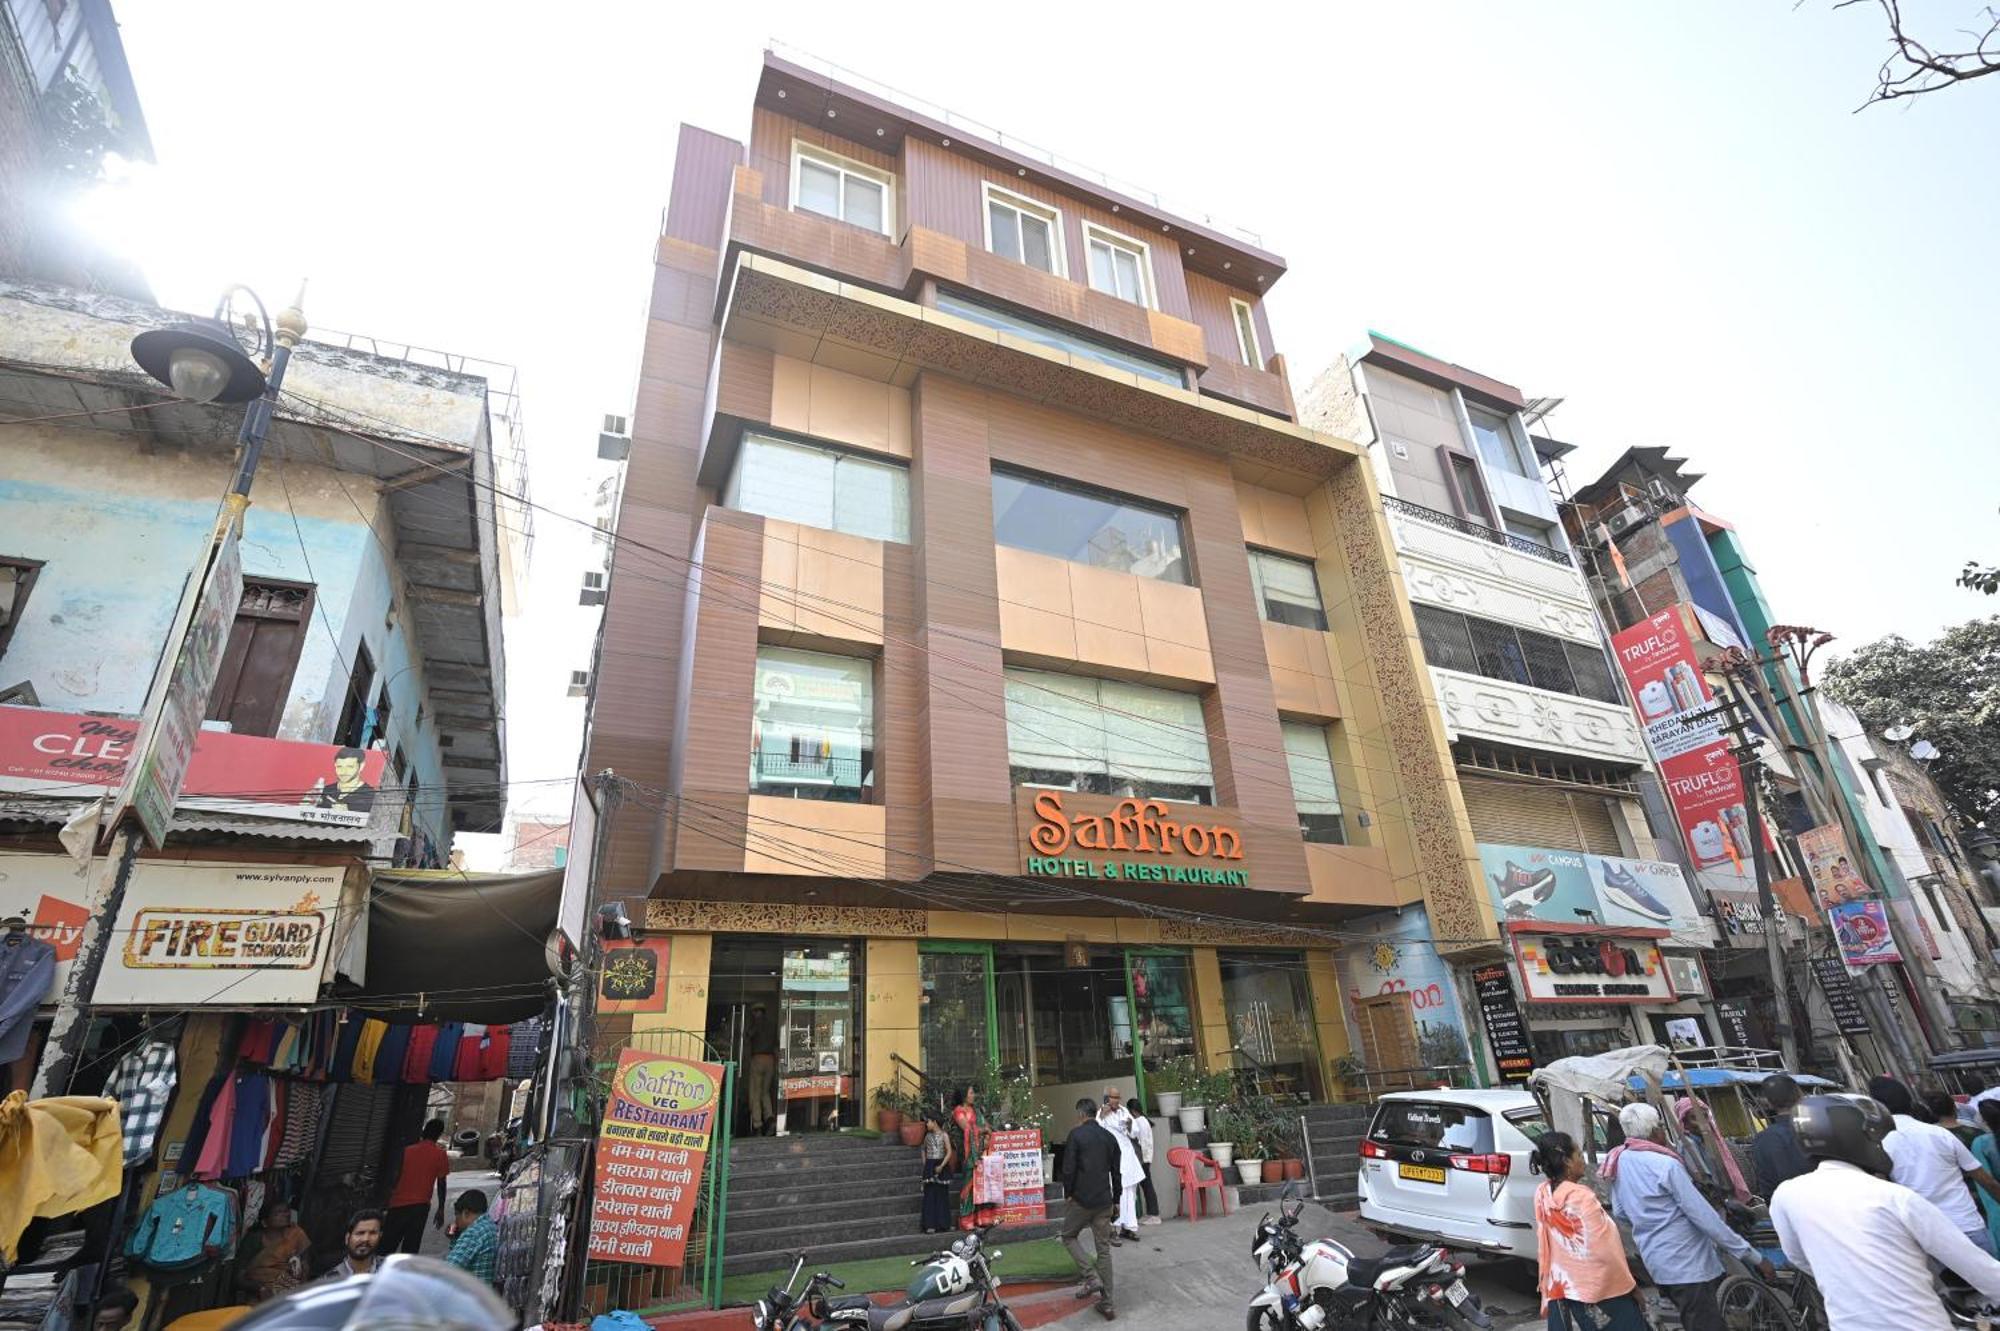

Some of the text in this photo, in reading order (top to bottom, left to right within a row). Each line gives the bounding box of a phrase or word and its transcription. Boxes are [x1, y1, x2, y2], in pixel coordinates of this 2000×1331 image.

[33, 734, 131, 760] CLE
[1030, 790, 1244, 860] Saffron
[236, 872, 334, 884] www.sylvanply.com
[1028, 857, 1248, 887] HOTEL & RESTAURANT
[140, 919, 313, 957] FIRE GUARD
[241, 943, 310, 957] TECHNOLOGY
[630, 1065, 705, 1100] Saffron
[652, 1096, 679, 1109] VEG
[614, 1099, 709, 1131] RESTAURANT
[636, 1126, 647, 1139] की
[657, 1150, 689, 1166] थाली
[606, 1162, 692, 1185] महाराजा थाली
[601, 1178, 682, 1202] डीलक्स थाली
[596, 1197, 673, 1220] स्पेशल थाली
[591, 1219, 619, 1234] साउथ
[659, 1223, 684, 1240] थाली
[588, 1234, 653, 1257] मिनी थाली
[936, 1266, 962, 1293] 04
